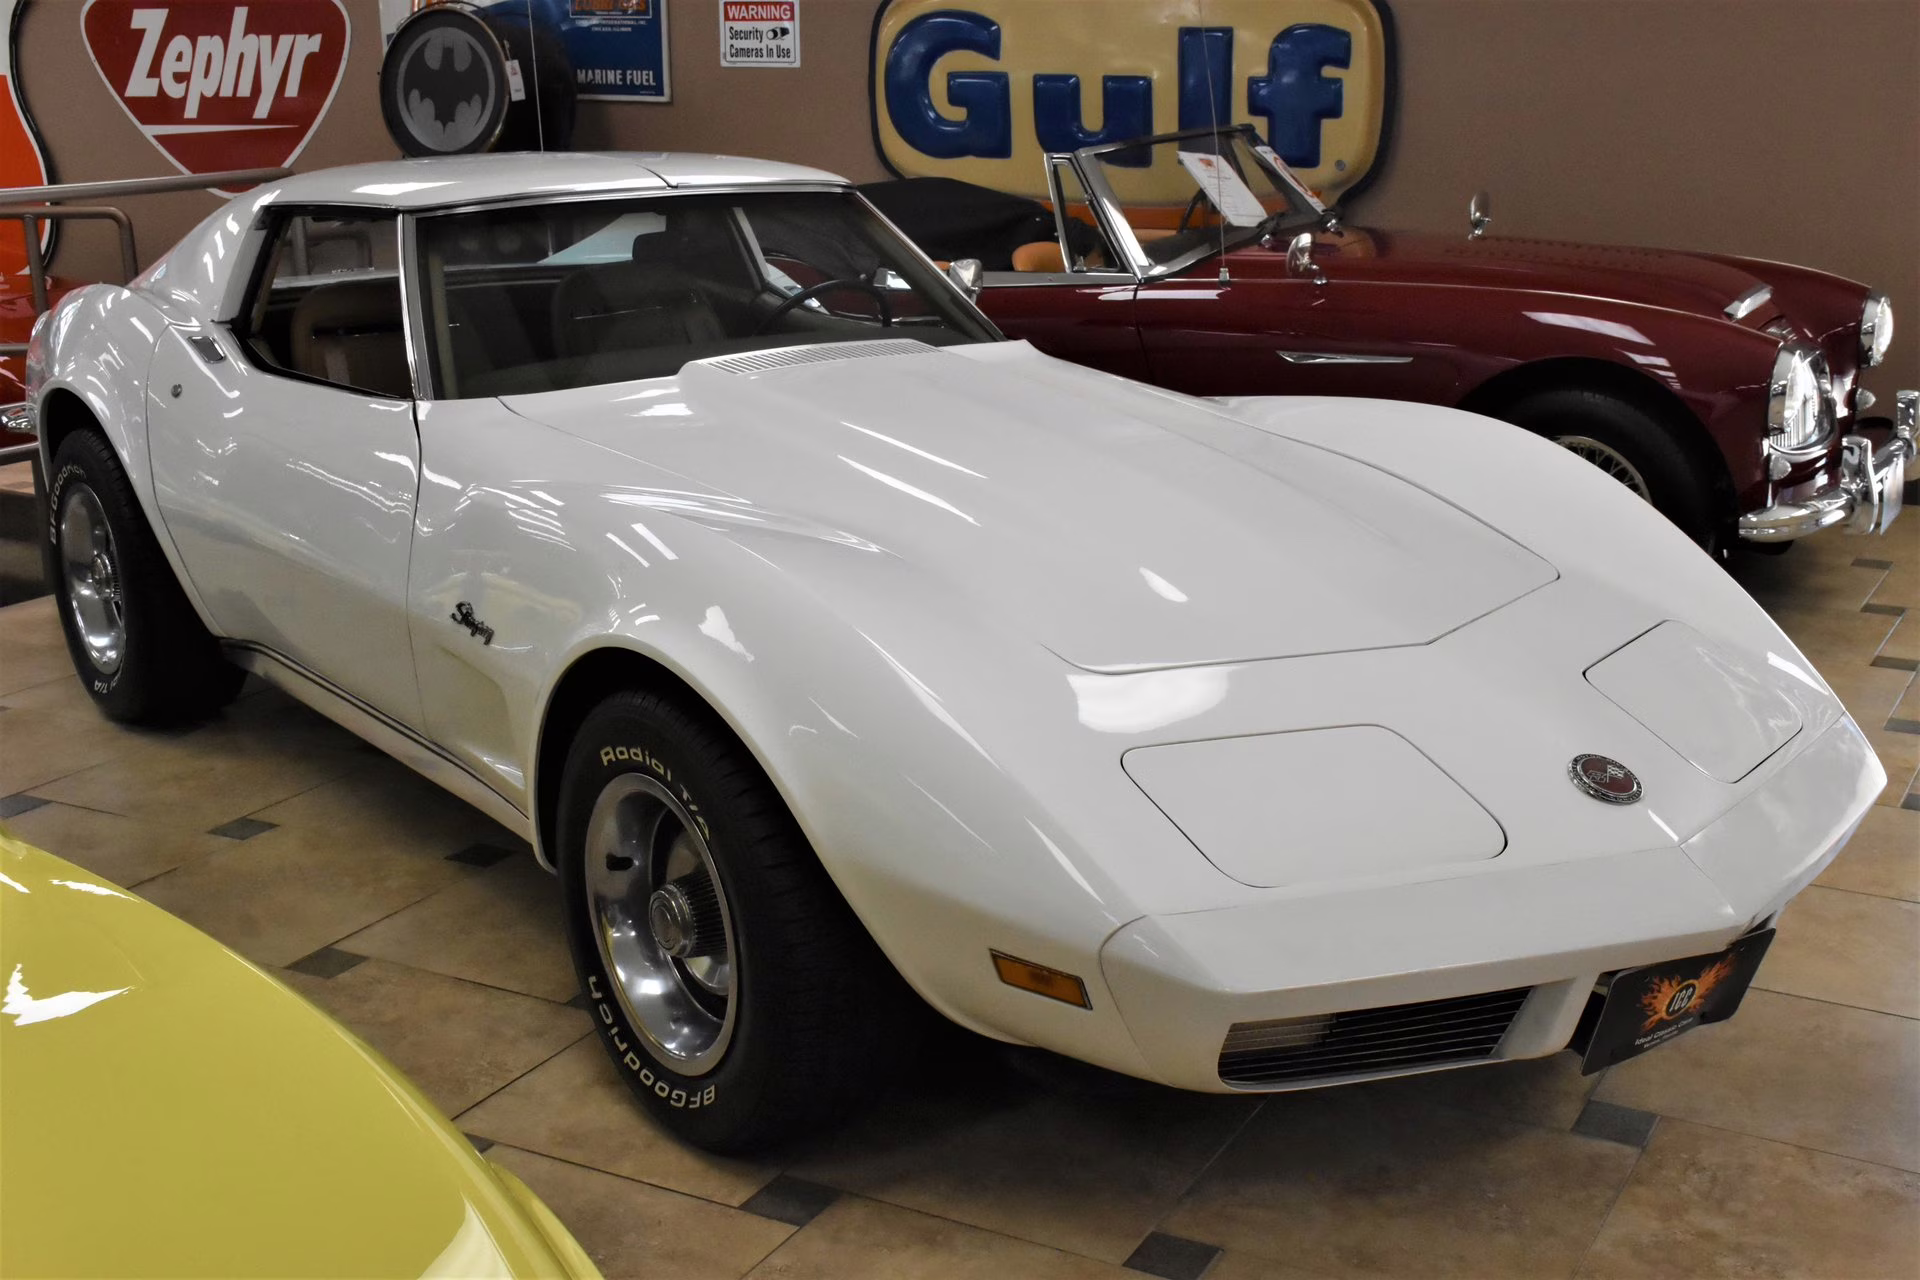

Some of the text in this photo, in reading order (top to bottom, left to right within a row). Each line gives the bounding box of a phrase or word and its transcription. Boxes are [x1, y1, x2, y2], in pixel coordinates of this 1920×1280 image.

[726, 4, 791, 20] WARNING
[729, 26, 763, 43] Security
[124, 6, 322, 119] Zephyr
[729, 43, 791, 59] Cameras In Use
[577, 68, 657, 86] MARINE FUEL
[884, 9, 1352, 168] Gulf
[600, 746, 672, 782] Radial
[588, 975, 716, 1109] BFGoodrich
